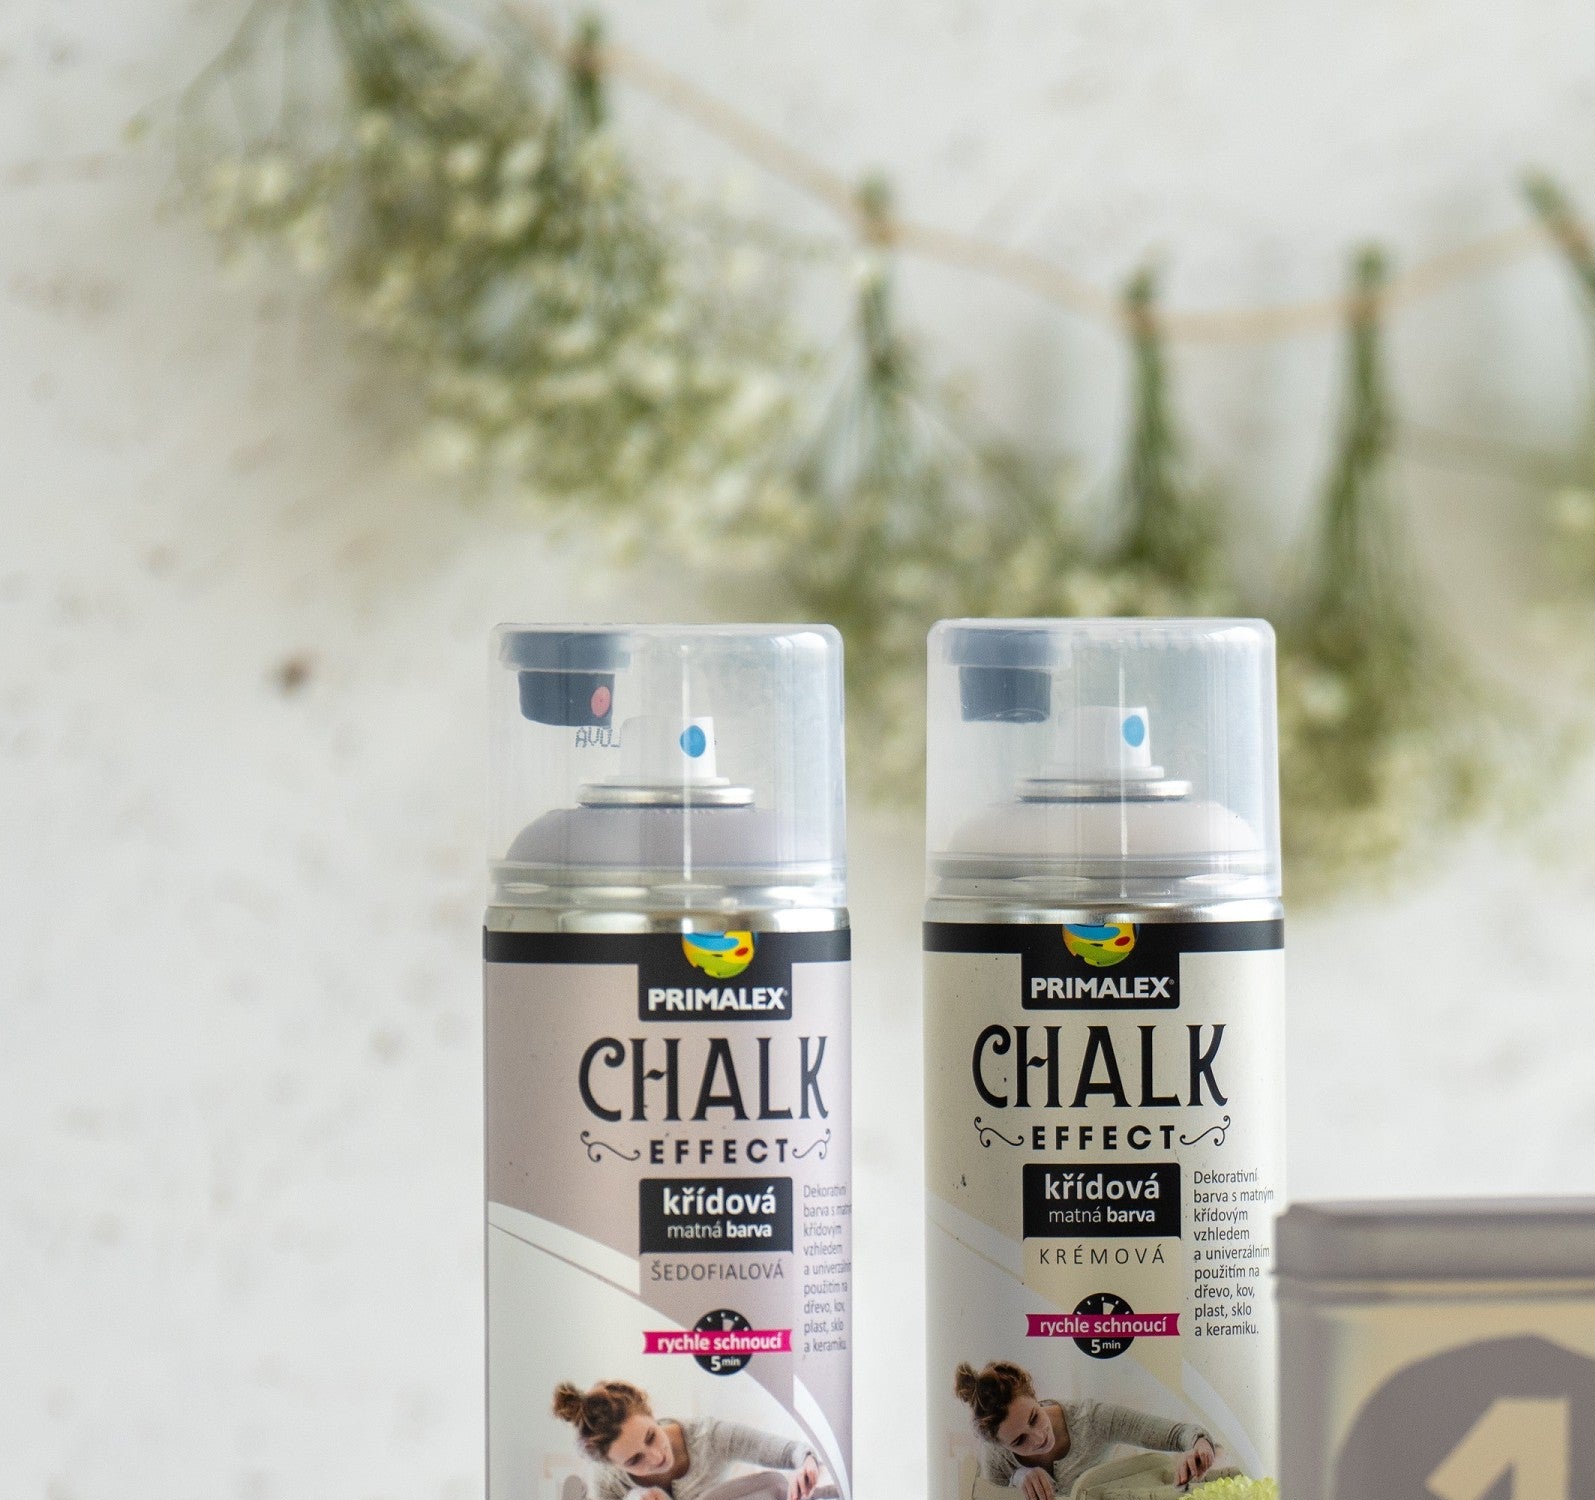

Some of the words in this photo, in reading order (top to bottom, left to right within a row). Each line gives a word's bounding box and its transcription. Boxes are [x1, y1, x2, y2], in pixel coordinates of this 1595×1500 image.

[648, 987, 785, 1011] PRIMALEX
[972, 1024, 1229, 1109] CHALK
[579, 1035, 829, 1122] CHALK
[1032, 1125, 1175, 1150] EFFECT
[650, 1138, 788, 1164] EFFECT
[1193, 1168, 1258, 1185] Dekorativní
[1045, 1172, 1160, 1200] křídová
[663, 1185, 777, 1216] křídová
[1193, 1190, 1229, 1204] barva
[1231, 1191, 1237, 1203] s
[1240, 1187, 1274, 1205] matným
[803, 1204, 829, 1218] barva
[1049, 1206, 1101, 1223] matná
[1106, 1206, 1155, 1223] barva
[1193, 1207, 1249, 1224] křídovým
[667, 1220, 722, 1239] matná
[726, 1219, 772, 1239] barva
[1193, 1227, 1250, 1242] vzhledem
[1040, 1243, 1165, 1265] KRÉMOVÁ
[1194, 1250, 1202, 1261] a
[1206, 1245, 1270, 1260] univerzálním
[651, 1258, 784, 1282] ŠEDOFIALOVÁ
[803, 1264, 810, 1276] a
[1194, 1265, 1246, 1282] použitím
[1248, 1266, 1260, 1277] na
[1194, 1284, 1233, 1300] dřevo,
[1236, 1283, 1255, 1299] kov,
[1194, 1304, 1228, 1320] plast,
[1231, 1302, 1252, 1317] sklo
[1040, 1317, 1089, 1336] rychle
[1094, 1316, 1167, 1333] schnoucí
[1194, 1325, 1202, 1337] a
[1206, 1321, 1259, 1337] keramiku.
[657, 1333, 710, 1353] rychle
[713, 1331, 782, 1351] schnoucí
[803, 1341, 810, 1353] a
[1091, 1339, 1100, 1354] 5
[1102, 1339, 1121, 1350] min
[710, 1355, 722, 1372] 5
[722, 1356, 741, 1367] min
